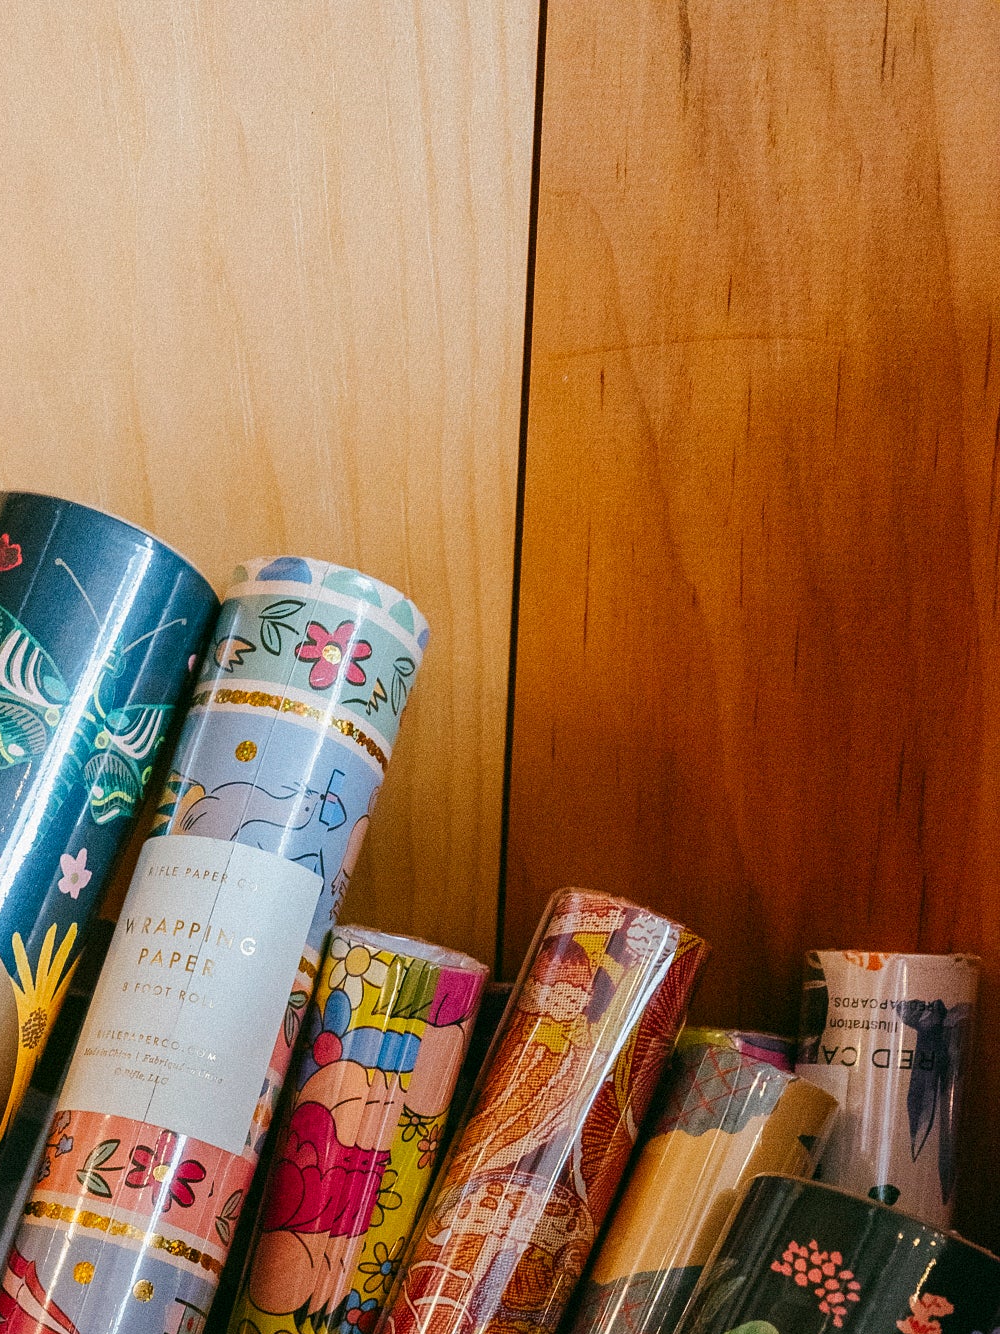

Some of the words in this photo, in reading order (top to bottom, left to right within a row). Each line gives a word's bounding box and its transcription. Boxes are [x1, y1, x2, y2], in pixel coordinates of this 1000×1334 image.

[185, 867, 228, 884] PAPER
[126, 917, 257, 956] WRAPPING
[137, 948, 216, 977] PAPER
[134, 982, 172, 997] FOOT
[871, 1048, 936, 1071] RED
